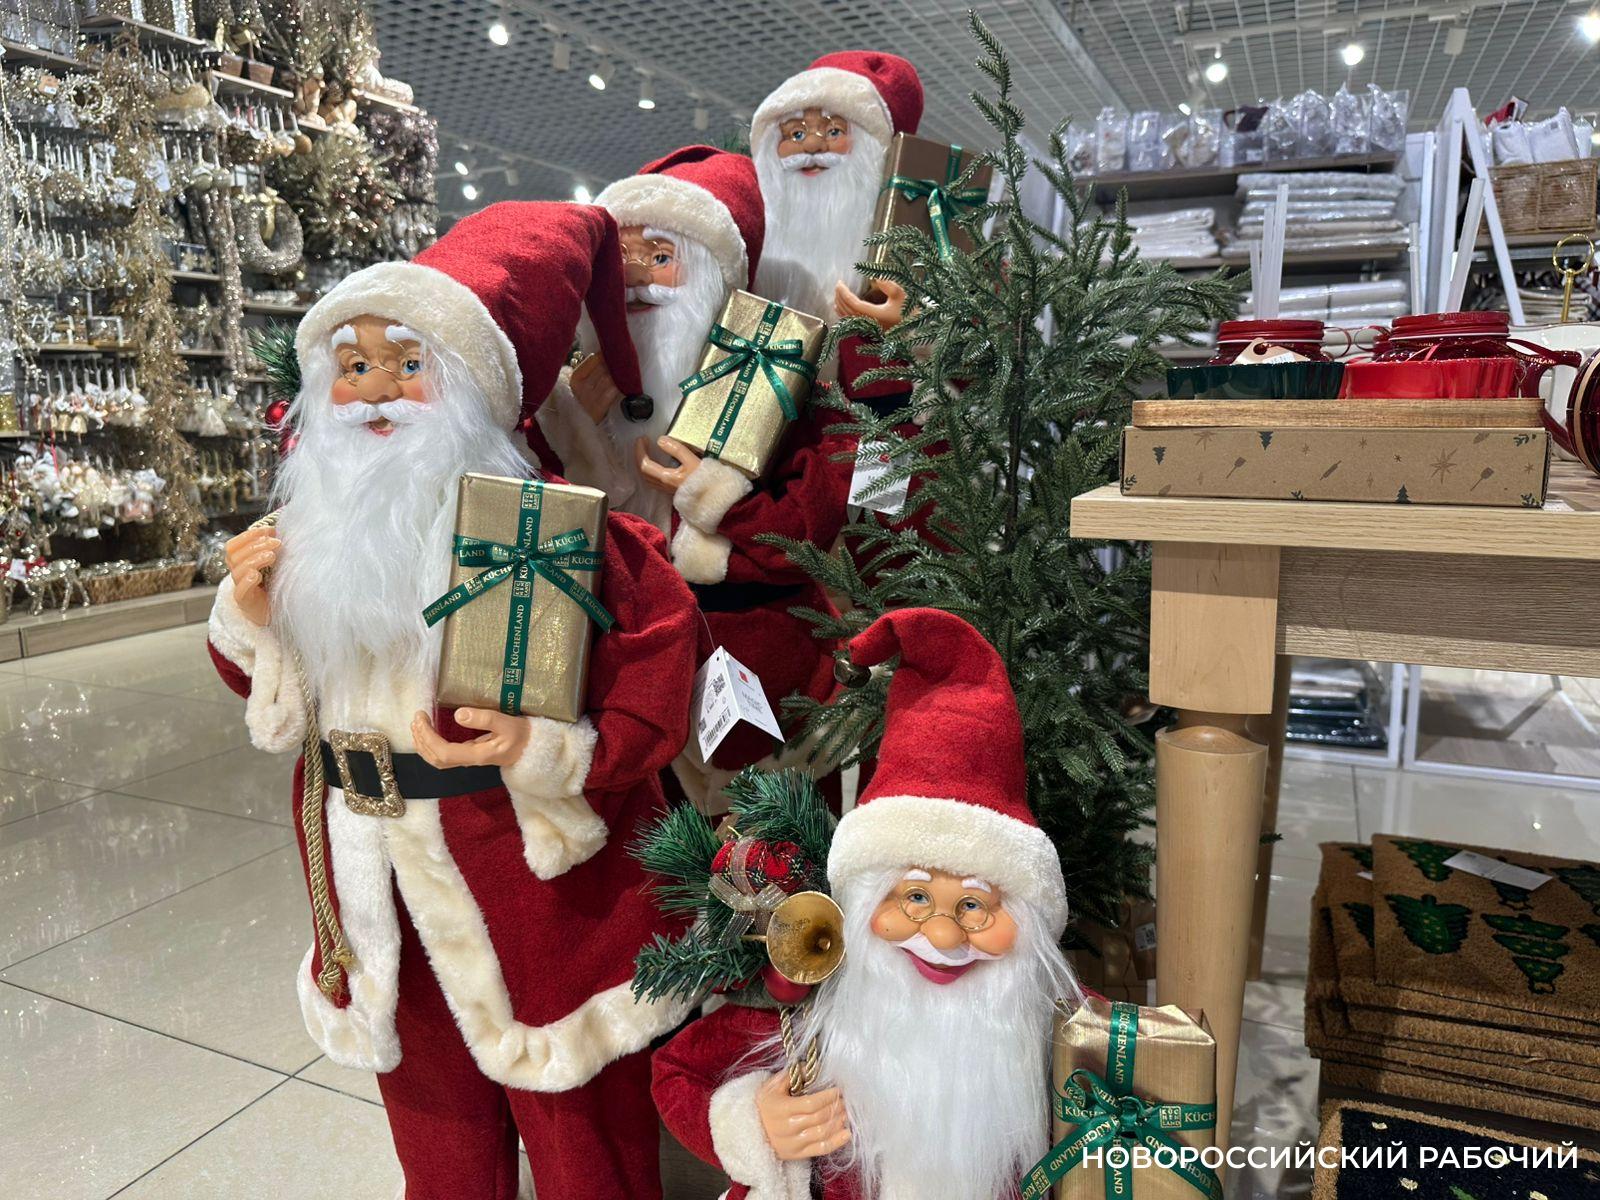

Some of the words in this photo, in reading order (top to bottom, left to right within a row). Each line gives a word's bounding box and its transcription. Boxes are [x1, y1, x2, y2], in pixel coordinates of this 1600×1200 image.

[510, 604, 525, 668] KÜCHENLAND
[1115, 1011, 1131, 1085] KÜCHENLAND
[1049, 1120, 1112, 1172] KÜCHENLAND
